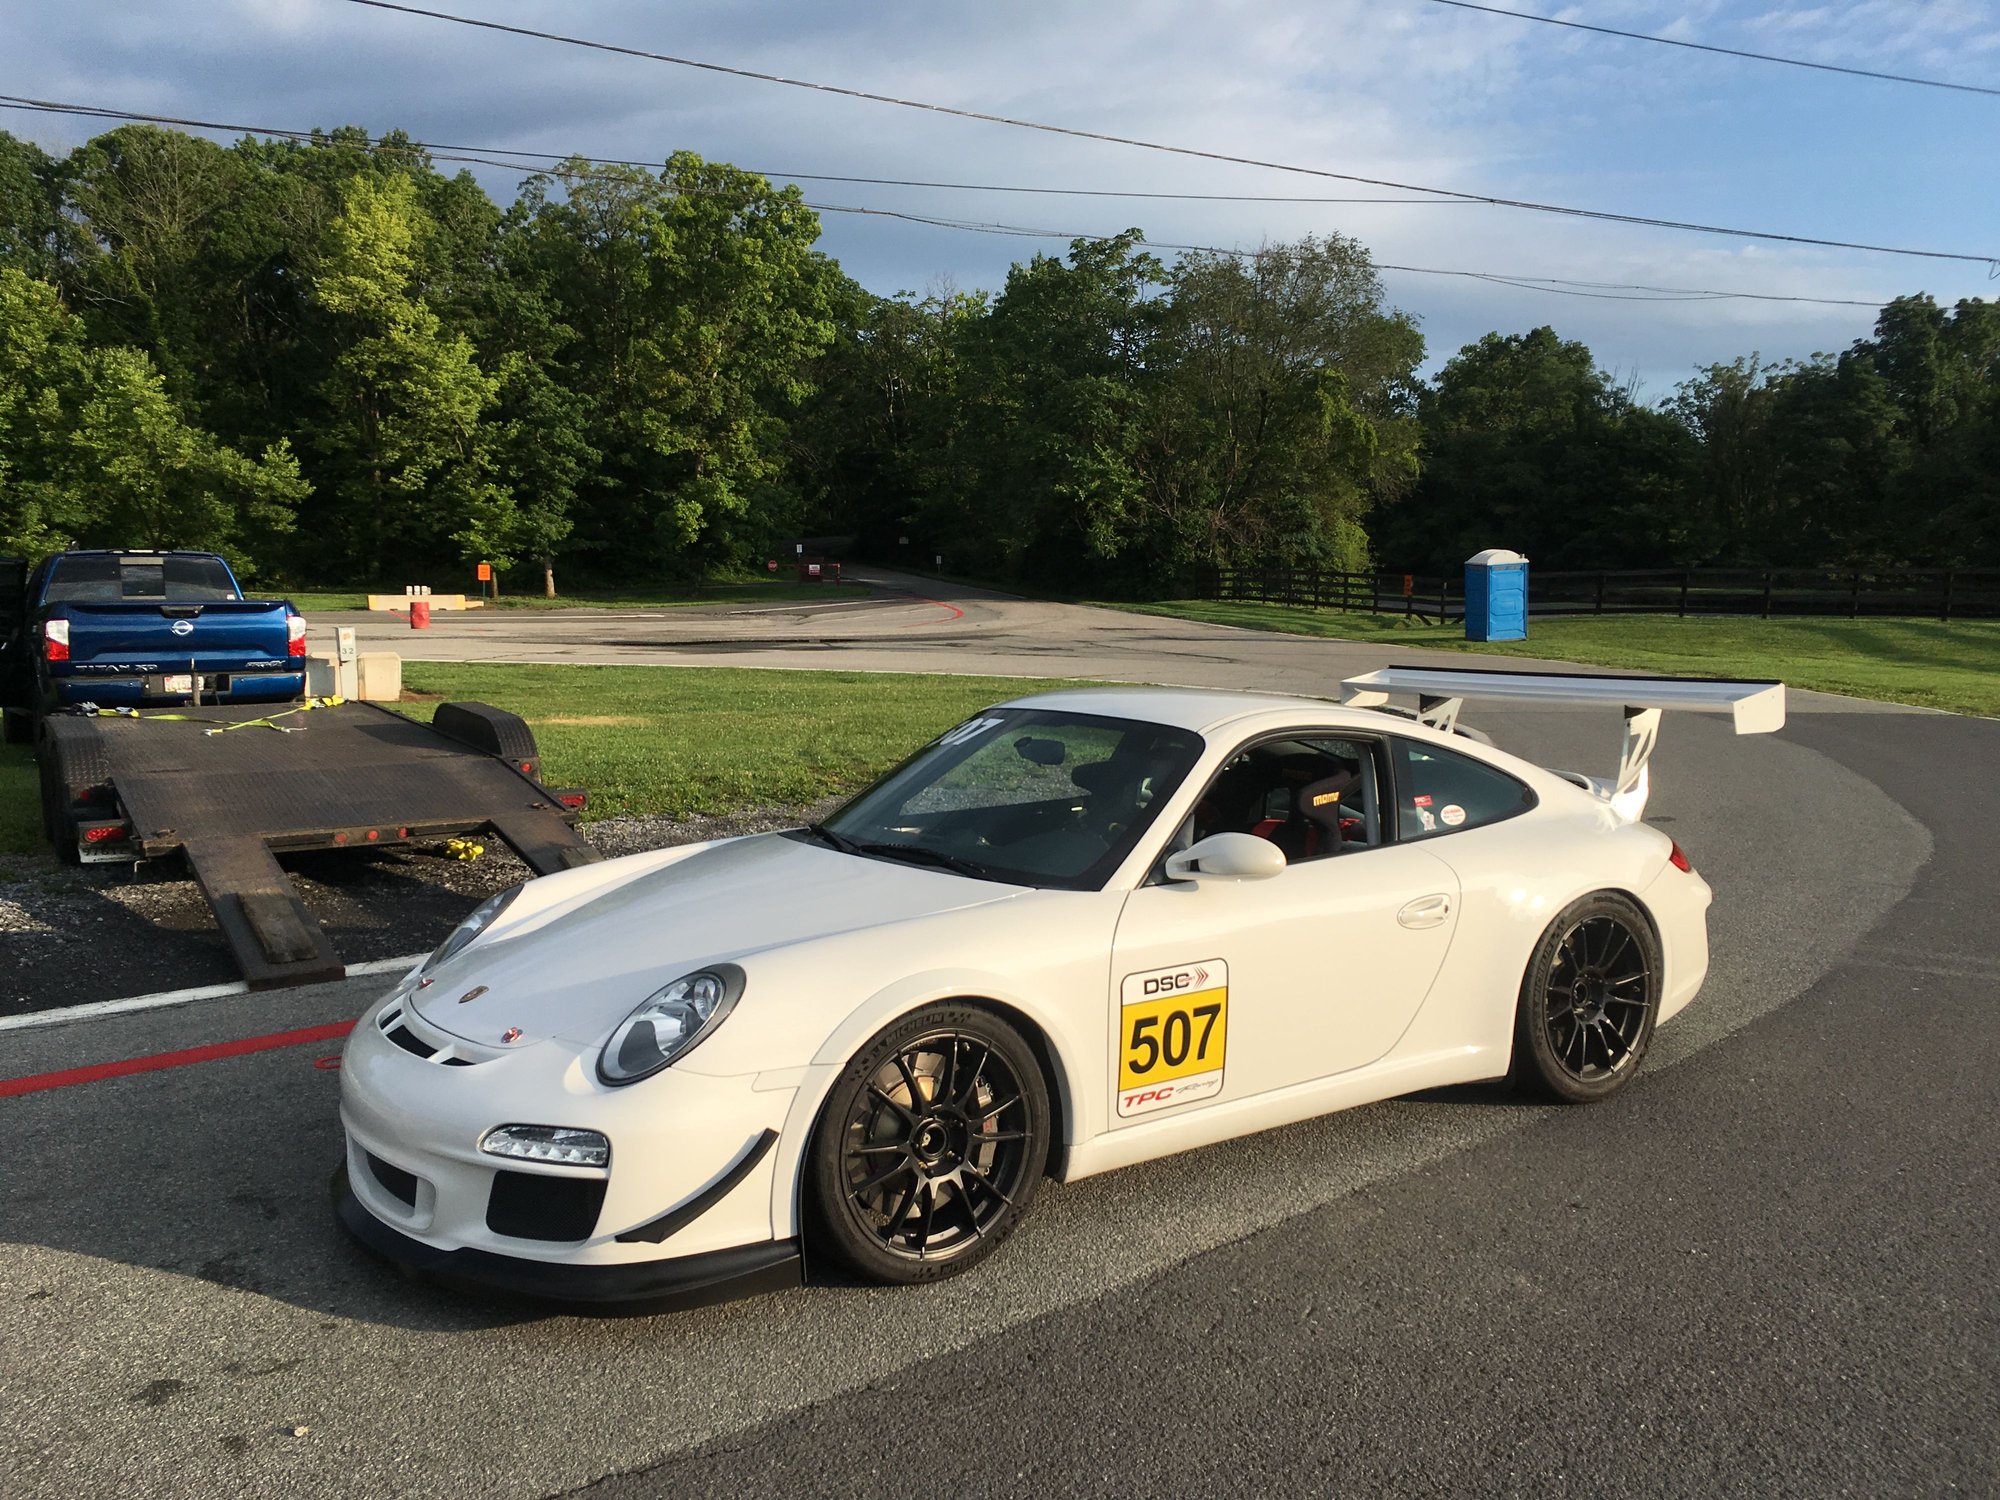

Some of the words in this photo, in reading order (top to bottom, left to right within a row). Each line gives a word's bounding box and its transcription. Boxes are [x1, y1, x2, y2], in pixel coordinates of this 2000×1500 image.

[75, 664, 130, 672] TITAN
[1144, 972, 1190, 995] DSC
[885, 1013, 944, 1044] MICHELIN
[1128, 1002, 1221, 1075] 507
[1124, 1087, 1175, 1108] TPC
